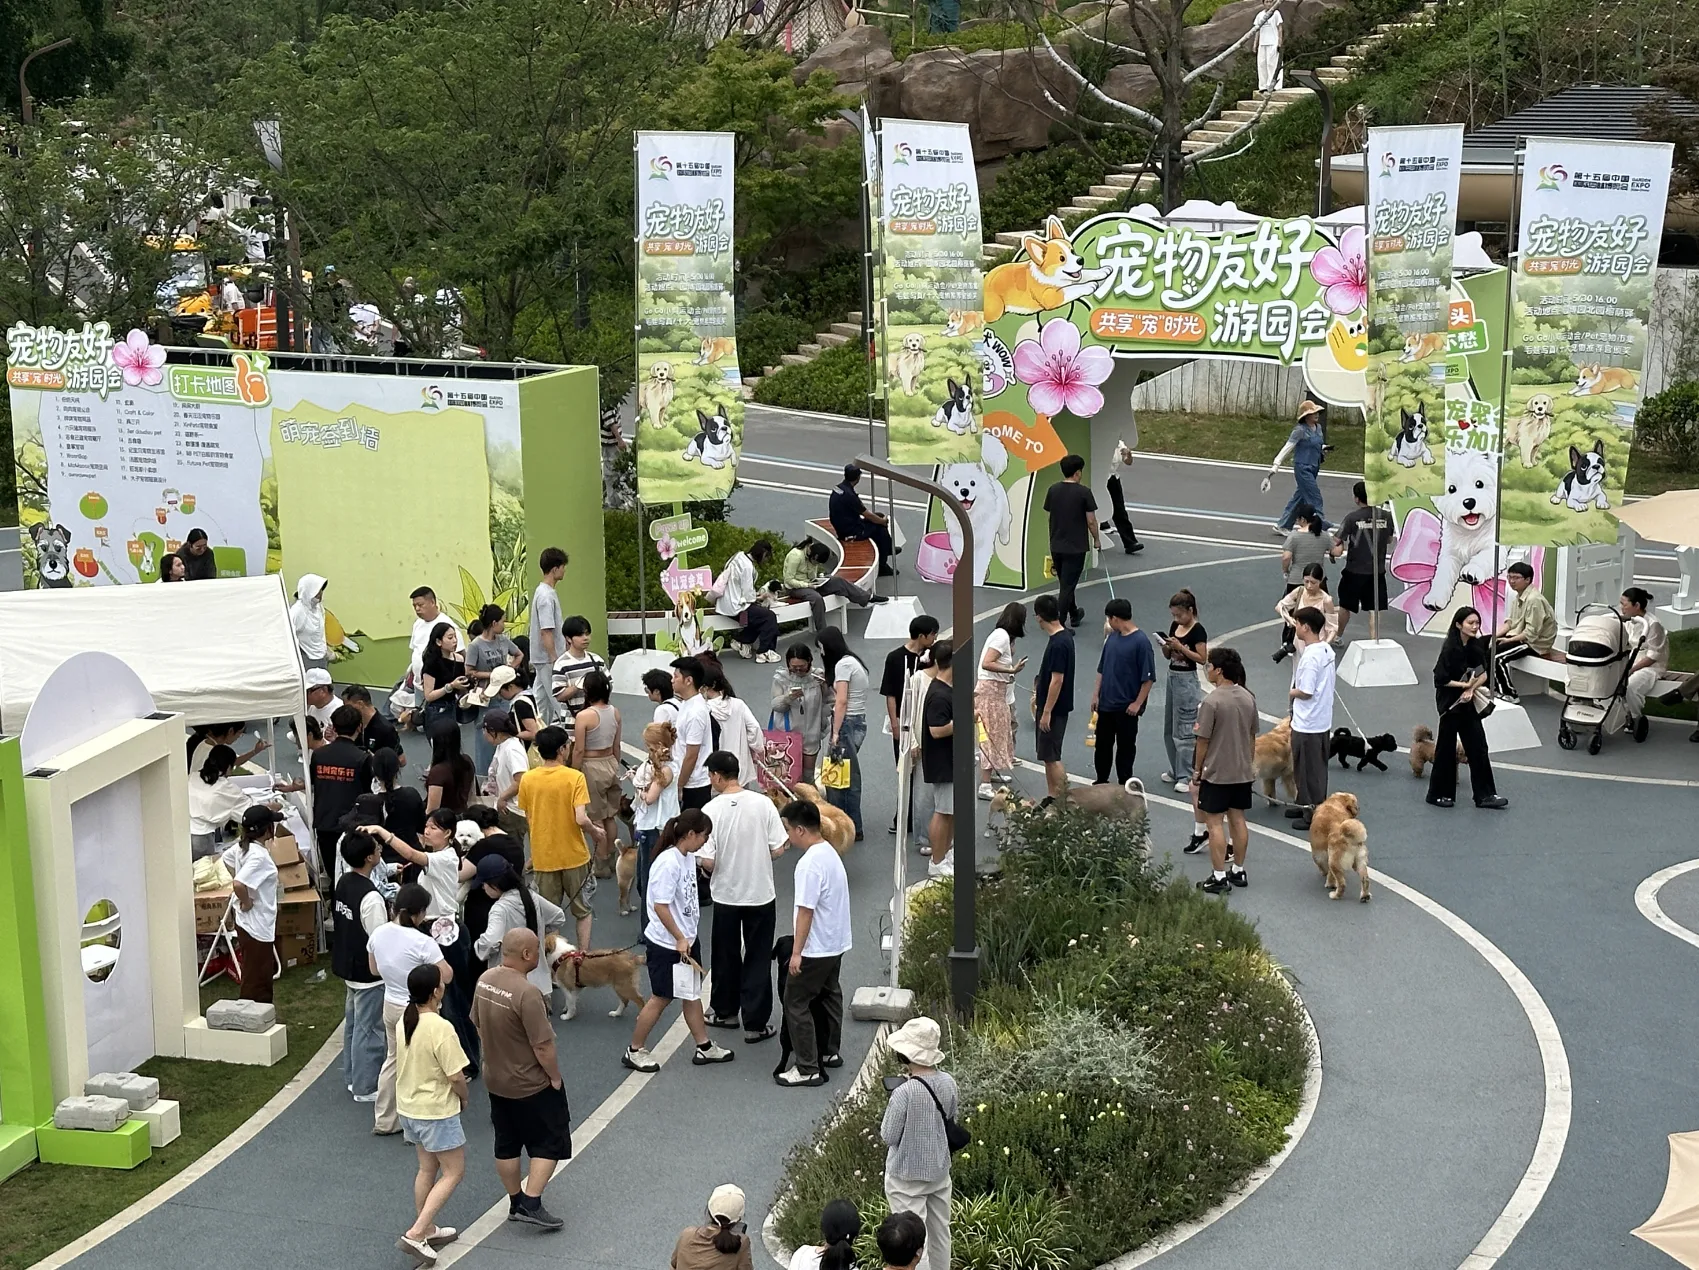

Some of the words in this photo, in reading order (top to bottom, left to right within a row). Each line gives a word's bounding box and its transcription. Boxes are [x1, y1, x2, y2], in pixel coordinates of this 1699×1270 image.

[1574, 172, 1631, 183] 第十五届中国
[891, 185, 970, 221] 宠物友好
[1373, 193, 1448, 237] 宠物友好
[645, 200, 725, 240] 宠物友好
[937, 215, 979, 240] 游园会
[695, 232, 729, 261] 游园会
[1406, 230, 1452, 255] 游园会
[1526, 216, 1648, 257] 宠物友好
[1093, 219, 1314, 308] 宠物友好
[1583, 254, 1651, 283] 游园会
[1595, 294, 1618, 305] 16:00
[1210, 300, 1331, 359] 游园会
[1451, 306, 1472, 327] 头
[8, 322, 114, 371] 宠物友好
[992, 340, 1013, 369] WOW
[66, 365, 123, 400] 游园会
[173, 373, 238, 397] 打卡地图
[278, 416, 380, 452] 萌宠签到墙
[1024, 437, 1044, 454] TO
[677, 534, 706, 547] welcome
